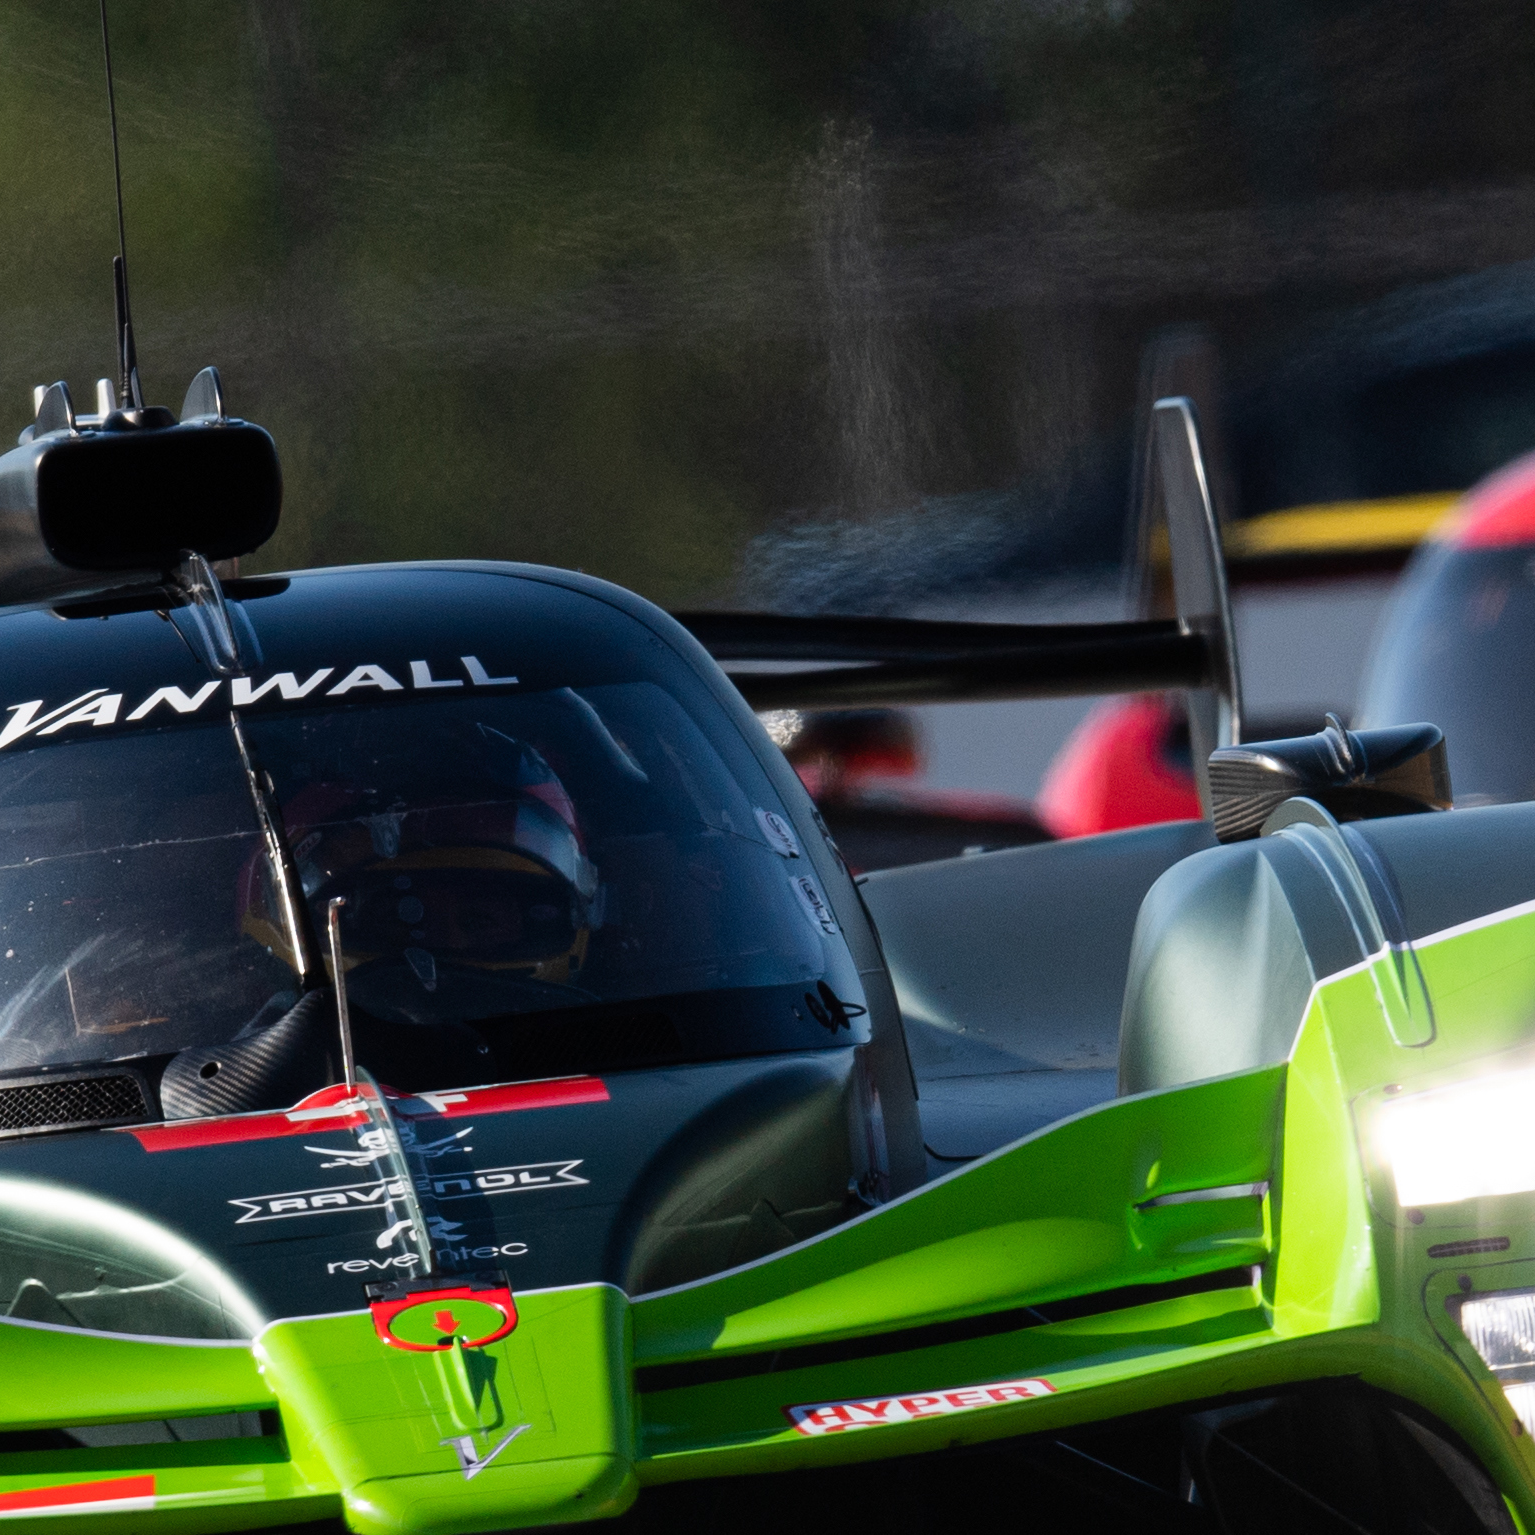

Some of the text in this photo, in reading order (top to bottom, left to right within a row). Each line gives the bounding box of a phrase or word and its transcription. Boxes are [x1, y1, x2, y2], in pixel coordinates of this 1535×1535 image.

[267, 1170, 551, 1213] RAVENOL
[326, 1241, 529, 1275] reventec
[809, 1385, 1038, 1426] HYPER
